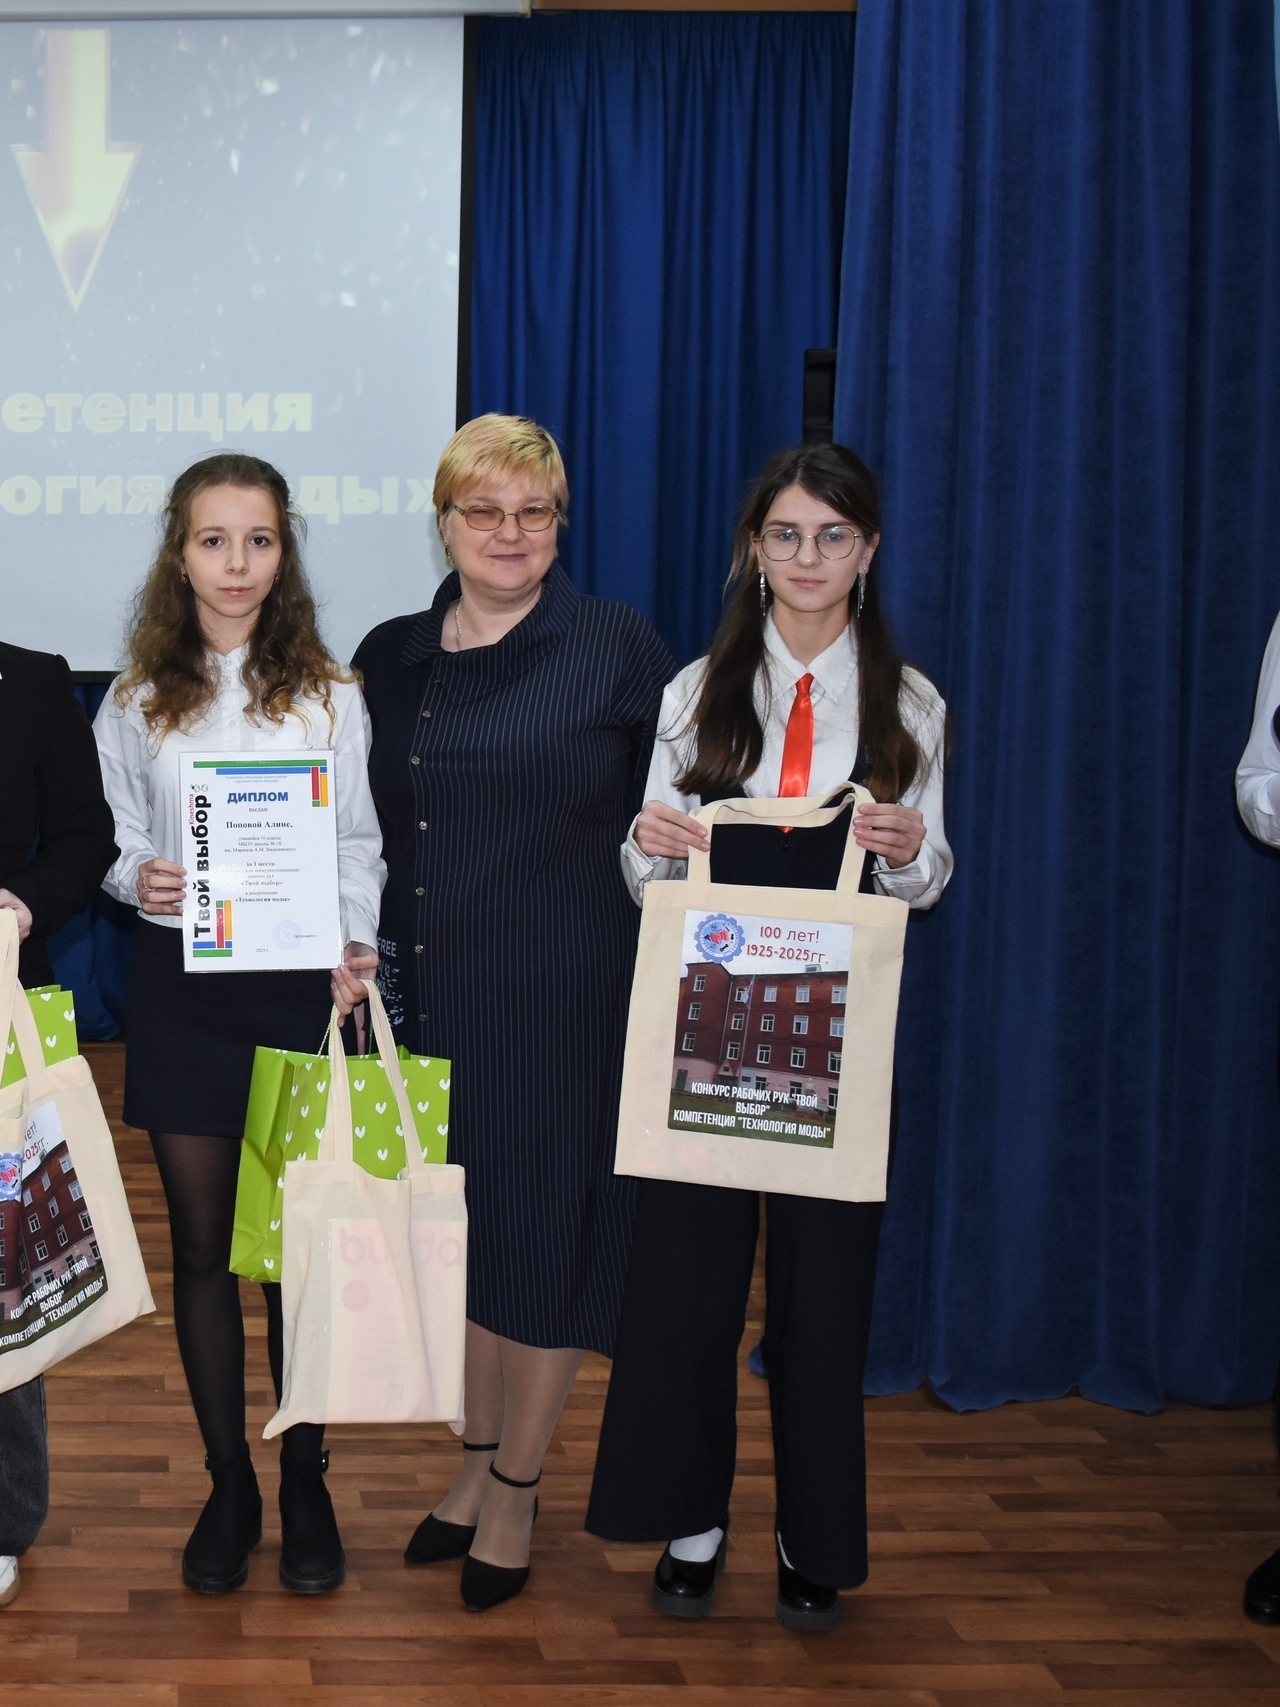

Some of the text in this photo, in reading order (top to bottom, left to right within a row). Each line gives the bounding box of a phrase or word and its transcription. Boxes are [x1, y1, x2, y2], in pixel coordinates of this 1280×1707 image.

[227, 792, 289, 804] ДИПЛОМ
[226, 821, 262, 829] Поповой
[191, 795, 211, 938] Твой выбор
[760, 926, 820, 943] 100 лет!
[746, 944, 829, 964] 1925-2025гг.
[691, 1082, 730, 1098] КОНКУРС
[731, 1086, 772, 1102] РАБОЧИХ
[735, 1101, 771, 1116] ВЫБОР"
[673, 1109, 831, 1139] КОМПЕТЕНЦИЯ "ТЕХНОЛОГИЯ МОДЫ"
[32, 1280, 62, 1303] РАБОЧИХ
[0, 1316, 46, 1347] КОМПЕТЕНЦИЯ
[85, 1276, 105, 1298] МОДЫ"
